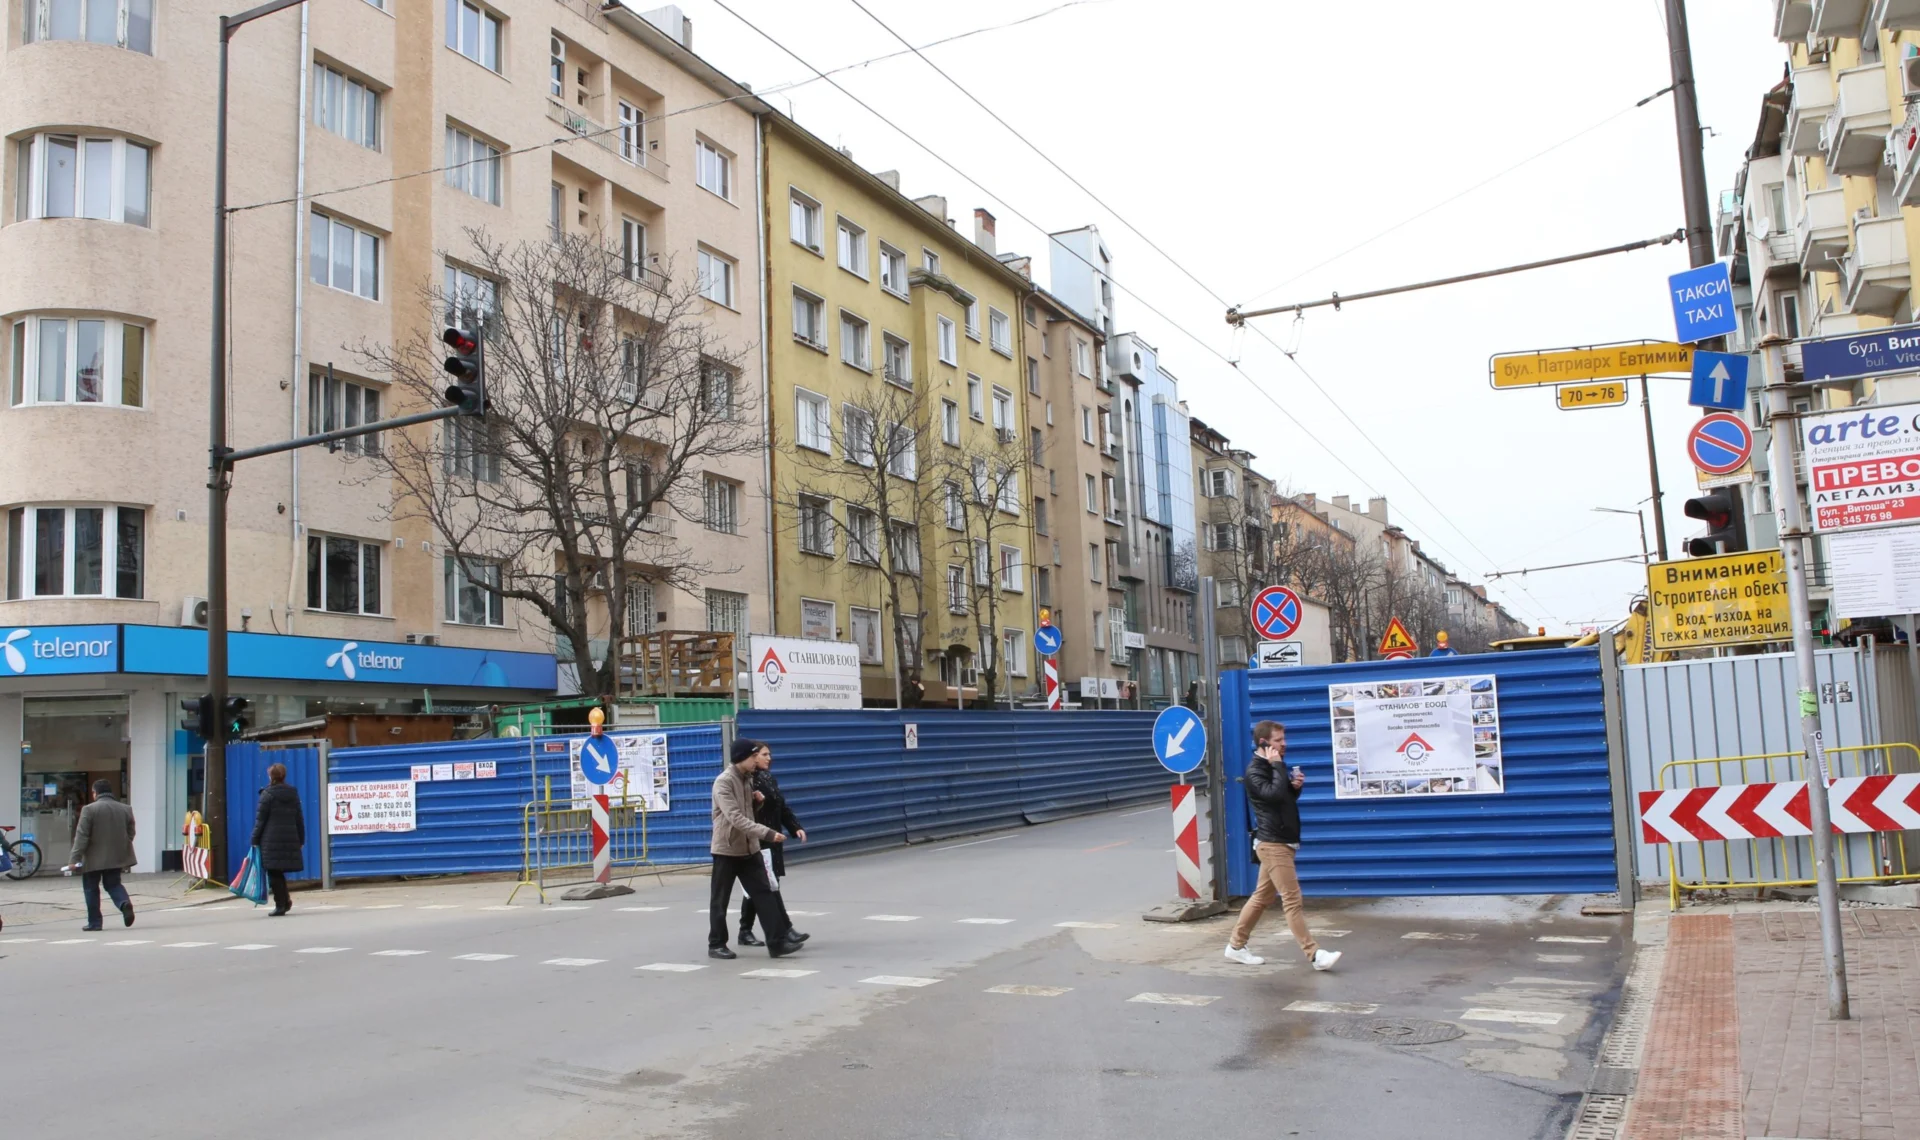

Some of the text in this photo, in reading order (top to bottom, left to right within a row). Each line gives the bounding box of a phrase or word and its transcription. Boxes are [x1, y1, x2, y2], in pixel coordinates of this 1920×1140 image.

[1675, 279, 1728, 303] ТАКСИ
[1685, 304, 1723, 324] TAXI
[1848, 341, 1882, 358] бул.
[1504, 348, 1689, 377] бул. Патриарх Евтимий
[1865, 356, 1889, 368] bul.
[1568, 387, 1615, 402] 70 76
[1811, 443, 1851, 456] Агенция
[1853, 442, 1865, 450] за
[1867, 437, 1902, 450] превод
[1817, 458, 1920, 488] ПРЕВО
[1816, 482, 1920, 503] ЛЕГАЛИЗ
[1820, 507, 1840, 517] бул.
[1892, 499, 1905, 508] 23
[1821, 511, 1892, 527] 089 345 76 98
[1666, 556, 1775, 584] Внимание!
[1653, 580, 1788, 609] Строителен обект
[1676, 608, 1772, 627] Вход-изход на
[1660, 630, 1698, 642] тежка
[32, 636, 112, 658] telenor
[357, 650, 405, 669] telenor
[788, 651, 857, 667] СТАНИЛОВ ЕООД
[1425, 701, 1448, 709] ЕООД
